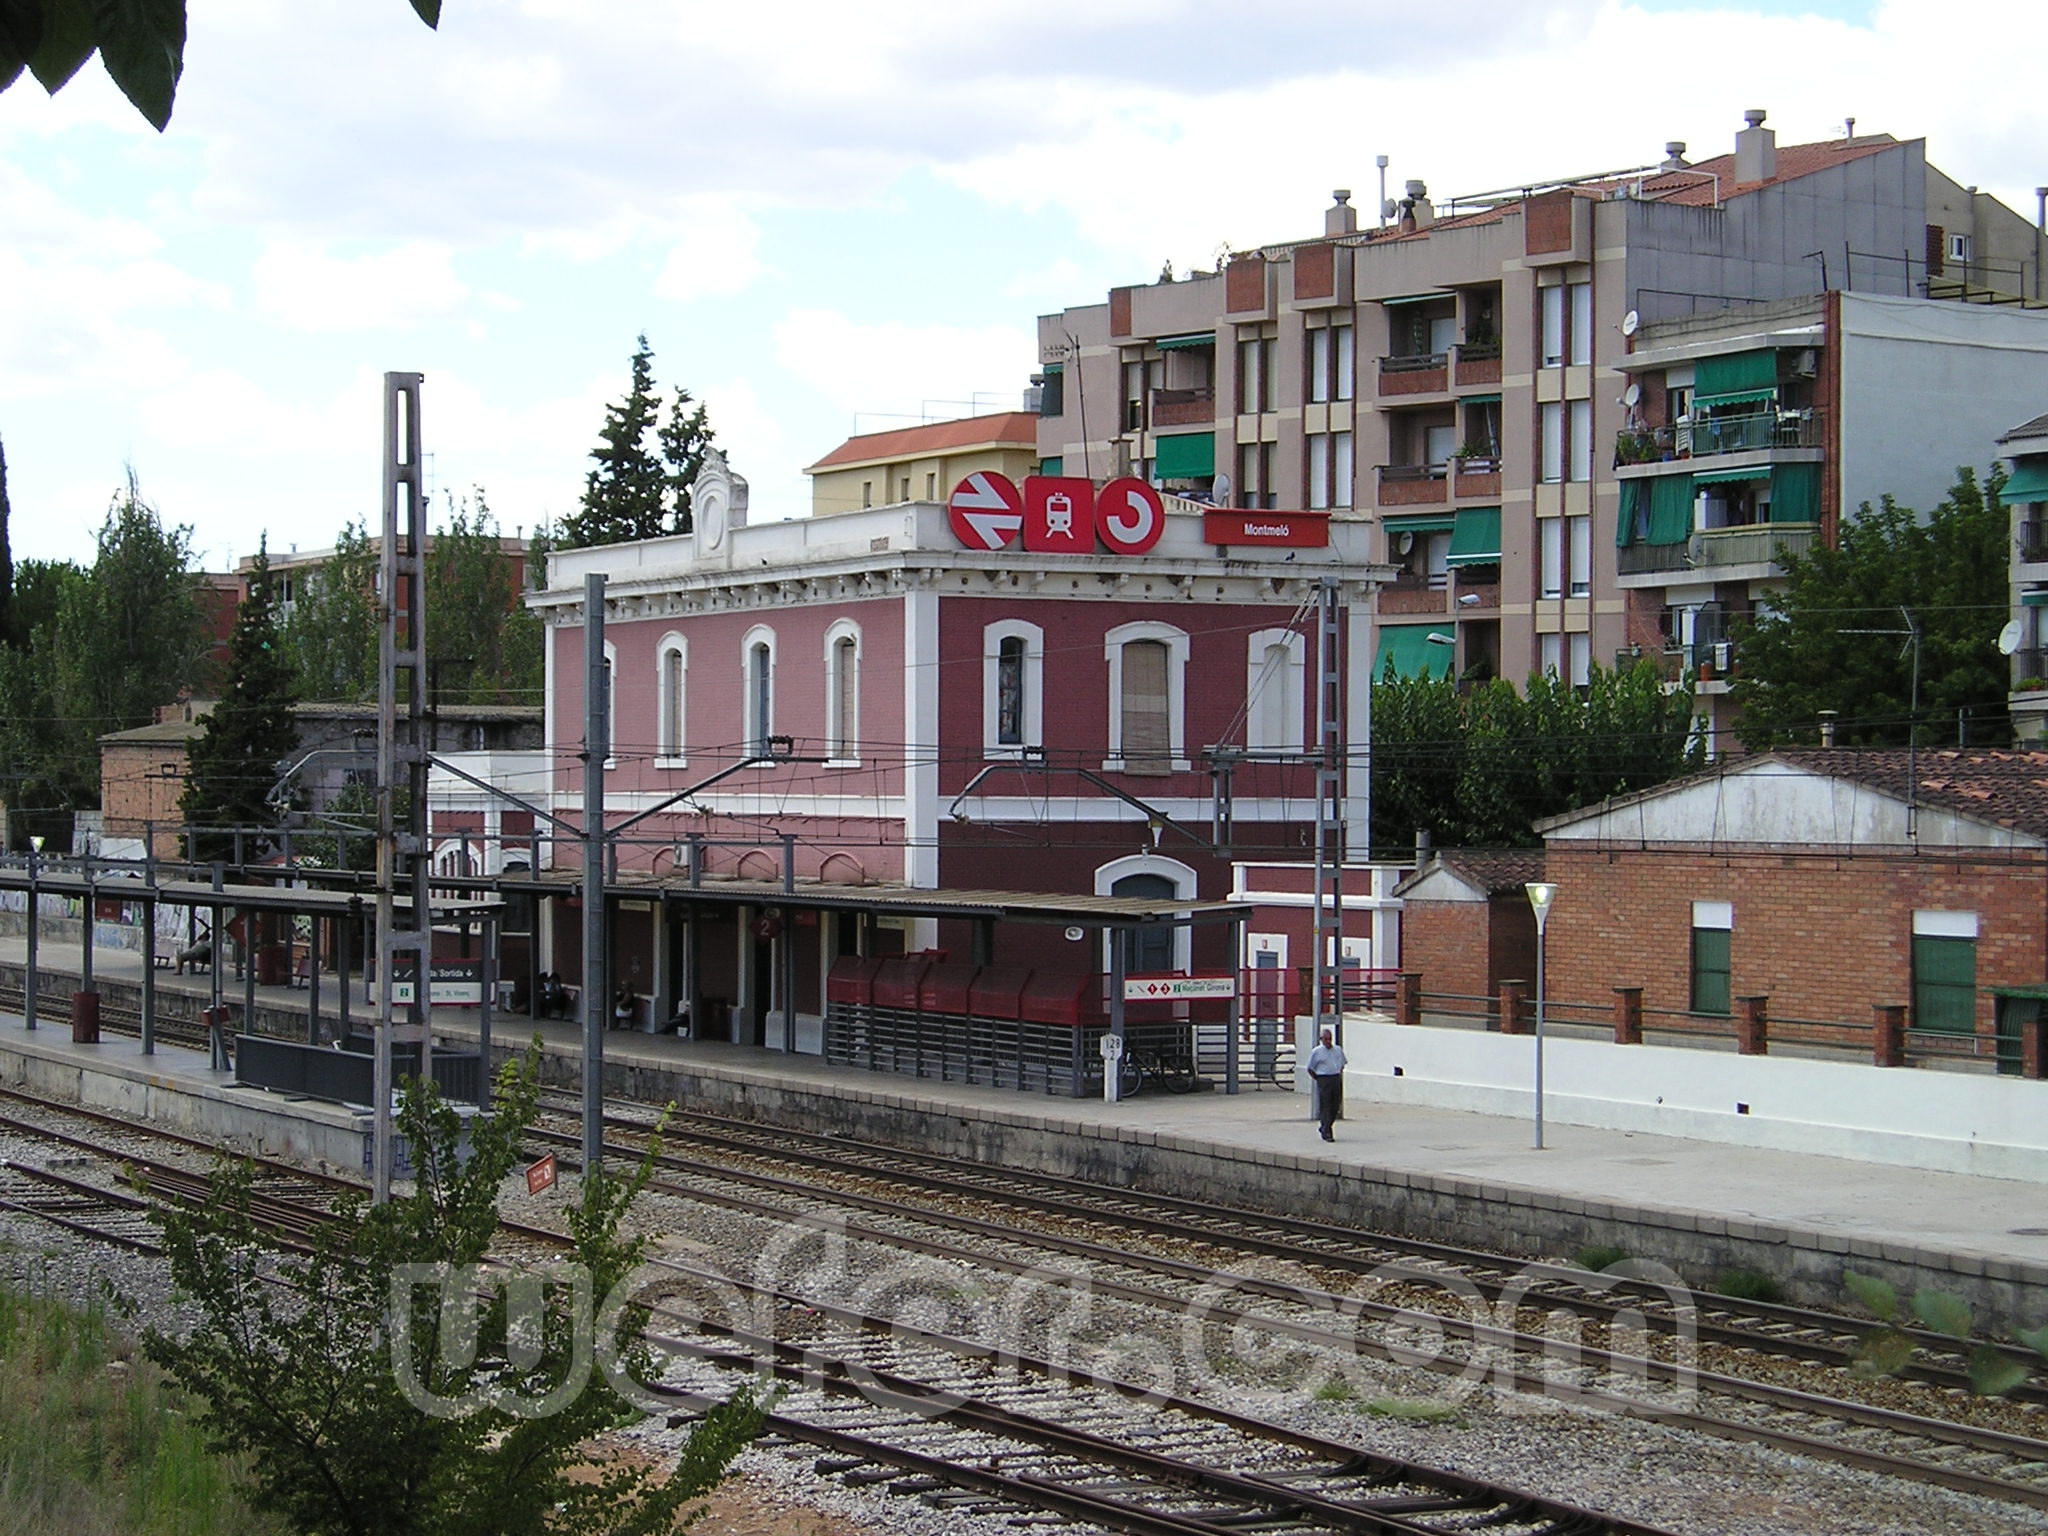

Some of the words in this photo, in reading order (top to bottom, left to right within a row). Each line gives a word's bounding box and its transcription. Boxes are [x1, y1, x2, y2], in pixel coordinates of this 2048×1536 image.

[1244, 523, 1289, 536] Montmeló
[760, 918, 770, 936] 2
[1109, 1050, 1115, 1061] 2
